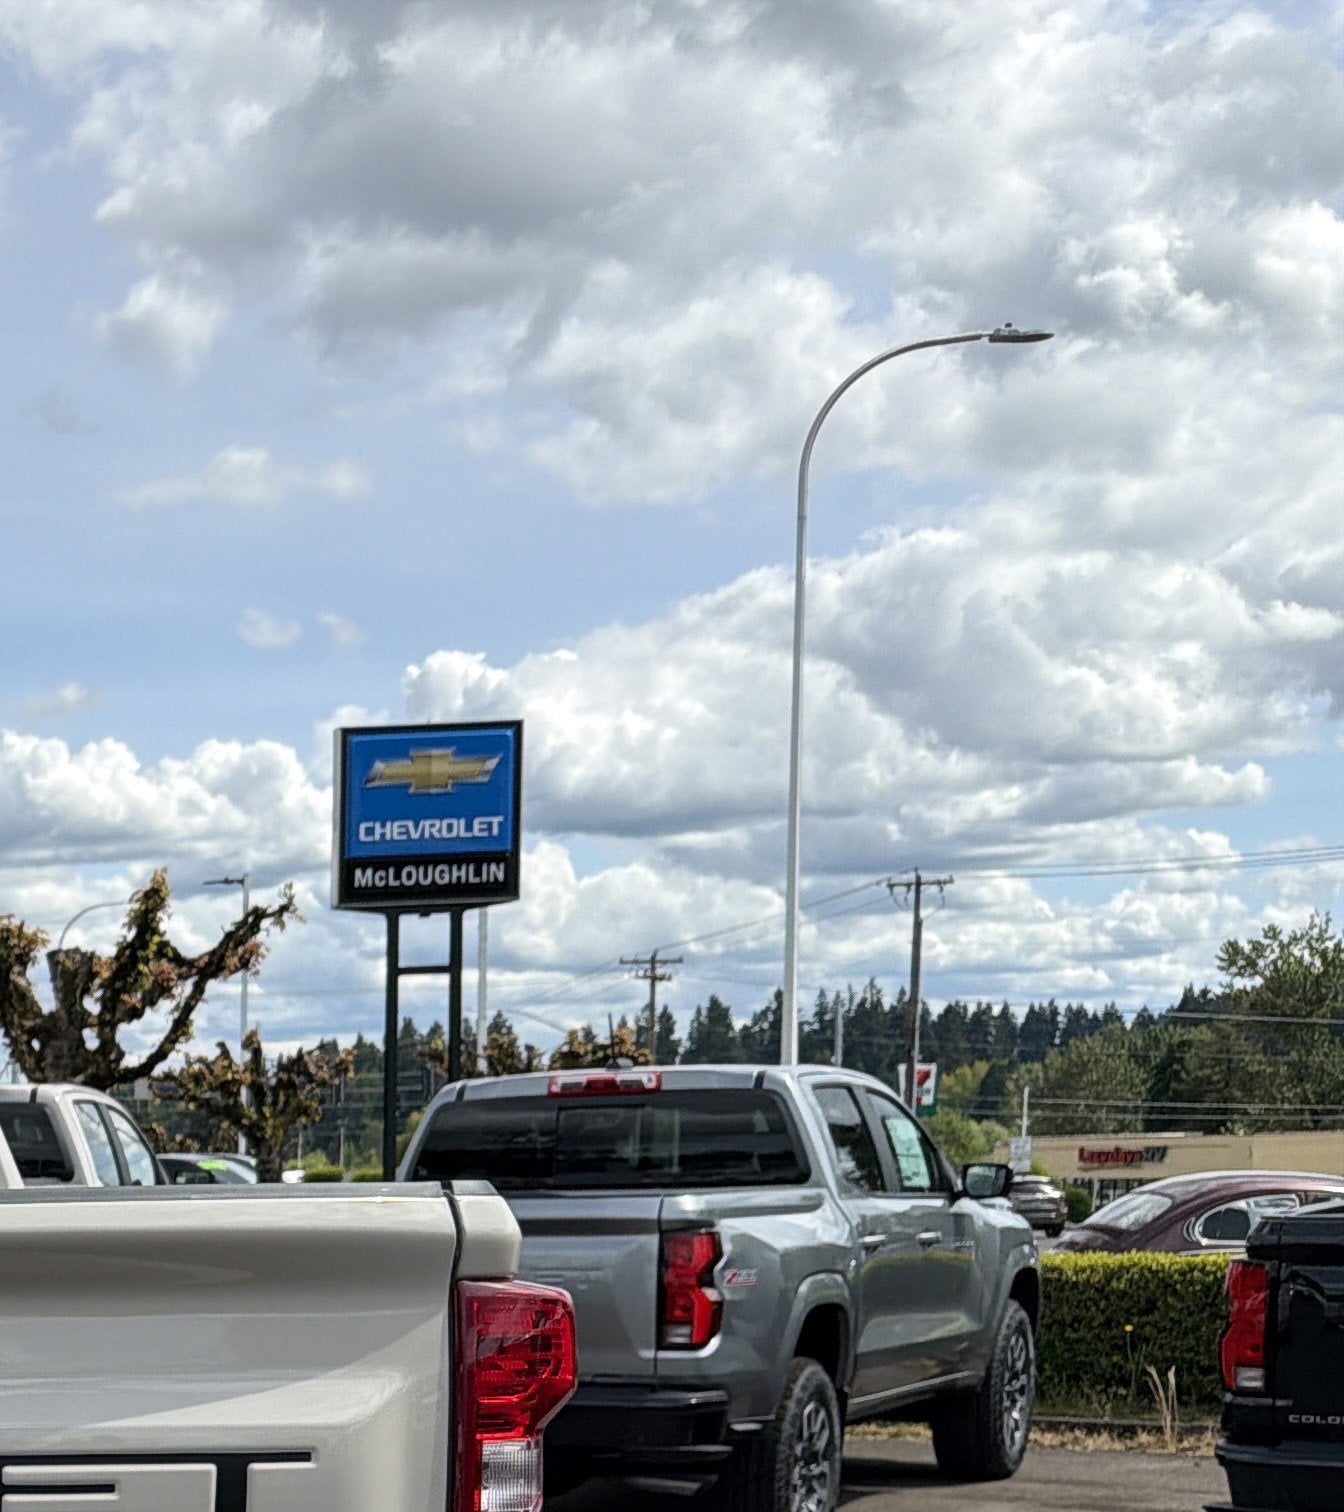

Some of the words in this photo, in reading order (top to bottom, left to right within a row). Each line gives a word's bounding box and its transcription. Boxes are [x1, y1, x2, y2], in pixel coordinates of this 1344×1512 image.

[359, 816, 505, 842] CHEVROLET
[353, 862, 506, 888] McLOUGHLIN
[1288, 1415, 1344, 1425] COLO
